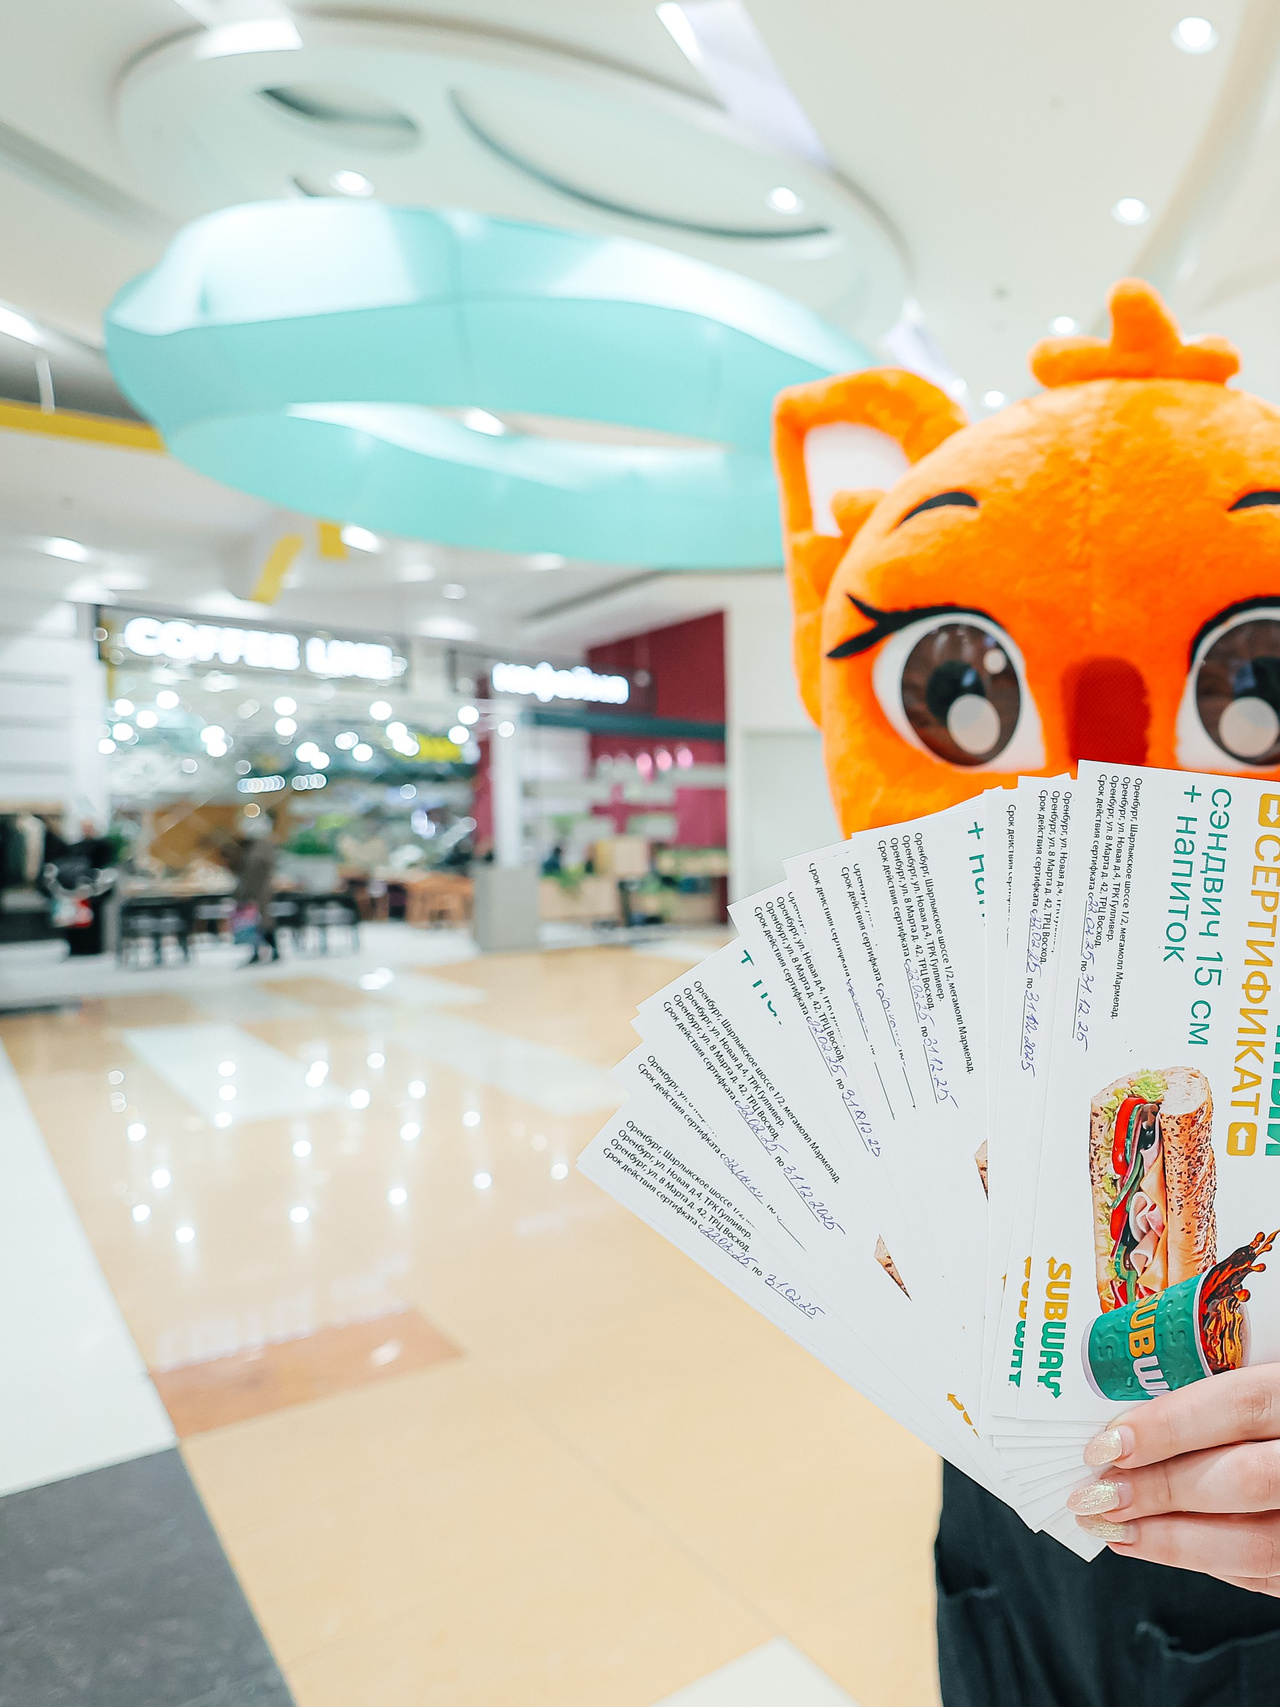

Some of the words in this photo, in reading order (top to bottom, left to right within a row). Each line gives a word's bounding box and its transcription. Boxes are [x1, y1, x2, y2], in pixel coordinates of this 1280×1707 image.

[1037, 789, 1047, 811] Срок
[1097, 774, 1106, 795] Срок
[1106, 775, 1118, 819] Оренбург,
[1118, 776, 1130, 820] Оренбург,
[1130, 778, 1142, 821] Оренбург,
[1048, 790, 1059, 834] Оренбург,
[1060, 791, 1071, 835] Оренбург,
[1093, 797, 1103, 838] действия
[1036, 813, 1044, 854] действия
[1115, 836, 1124, 862] Новая
[1125, 824, 1137, 879] Шарлыкское
[877, 840, 887, 862] Срок
[882, 865, 897, 904] действия
[889, 837, 905, 882] Оренбург,
[901, 835, 917, 879] Оренбург,
[913, 832, 929, 877] Оренбург,
[1044, 859, 1054, 885] Марта
[1058, 852, 1067, 878] Новая
[1100, 871, 1107, 879] д.
[1102, 842, 1112, 869] Марта
[898, 883, 908, 896] ул.
[910, 881, 919, 893] ул.
[924, 878, 942, 934] Шарлыкское
[1043, 898, 1051, 910] 42,
[1044, 887, 1051, 895] д.
[1095, 896, 1107, 912] ТРЦ
[1099, 882, 1107, 893] 42,
[1111, 882, 1120, 898] ТРК
[1122, 881, 1130, 907] шоссе
[1162, 813, 1198, 963] напиток
[905, 905, 916, 933] Марта
[915, 895, 926, 922] Новая
[1041, 913, 1051, 929] ТРЦ
[1105, 900, 1118, 941] Гулливер.
[1120, 911, 1128, 925] 1/2,
[776, 896, 799, 939] Оренбург,
[794, 939, 804, 951] ул.
[802, 951, 818, 978] Новая
[915, 944, 923, 957] 42,
[926, 940, 936, 957] ТРК
[937, 936, 948, 963] шоссе
[1039, 932, 1049, 964] Восход.
[1094, 915, 1104, 948] Восход.
[1116, 927, 1125, 969] мегамолл
[765, 901, 788, 944] Оренбург,
[783, 944, 793, 957] ул.
[794, 964, 810, 990] Марта
[812, 1001, 821, 1013] 42,
[818, 1012, 831, 1031] ТРЦ
[826, 1030, 843, 1062] Восход.
[918, 957, 928, 976] ТРЦ
[929, 958, 944, 1001] Гулливер.
[944, 965, 953, 981] 1/2,
[1080, 960, 1086, 971] по
[1195, 950, 1223, 987] 15
[754, 907, 767, 928] Срок
[763, 930, 785, 967] действия
[835, 1078, 844, 1089] по
[922, 977, 934, 1010] Восход.
[948, 983, 962, 1024] мегамолл
[1110, 972, 1123, 1019] Мармелад.
[673, 994, 702, 1034] Оренбург,
[699, 1033, 710, 1045] ул.
[713, 1050, 733, 1075] Марта
[738, 1084, 747, 1096] 42,
[746, 1094, 760, 1113] ТРЦ
[757, 1110, 778, 1141] Восход.
[683, 988, 712, 1027] Оренбург,
[708, 1026, 720, 1038] ул.
[719, 1037, 738, 1062] Новая
[747, 1075, 761, 1091] ТРК
[757, 1090, 784, 1128] Гулливер.
[958, 1026, 973, 1073] Мармелад.
[663, 1001, 679, 1022] Срок
[675, 1022, 704, 1057] действия
[774, 1156, 783, 1166] по
[693, 981, 722, 1020] Оренбург,
[721, 1019, 757, 1067] Шарлыкское
[755, 1067, 774, 1091] шоссе
[773, 1091, 784, 1107] 1/2,
[782, 1106, 811, 1143] мегамолл
[809, 1142, 839, 1183] Мармелад.
[626, 1120, 662, 1153] Оренбург,
[662, 1149, 709, 1189] Шарлыкское
[708, 1187, 732, 1207] шоссе
[610, 1139, 647, 1171] Оренбург,
[646, 1168, 657, 1179] ул.
[664, 1181, 688, 1203] Марта
[686, 1201, 694, 1209] д.
[696, 1208, 706, 1218] 42,
[708, 1215, 723, 1231] ТРЦ
[722, 1227, 749, 1252] Восход.
[618, 1130, 654, 1162] Оренбург,
[653, 1160, 665, 1170] ул.
[666, 1167, 689, 1189] Новая
[704, 1196, 719, 1211] ТРК
[717, 1208, 750, 1239] Гулливер.
[603, 1148, 622, 1165] Срок
[620, 1164, 656, 1192] действия
[751, 1267, 762, 1276] по
[1036, 1256, 1072, 1399] SUBWAY
